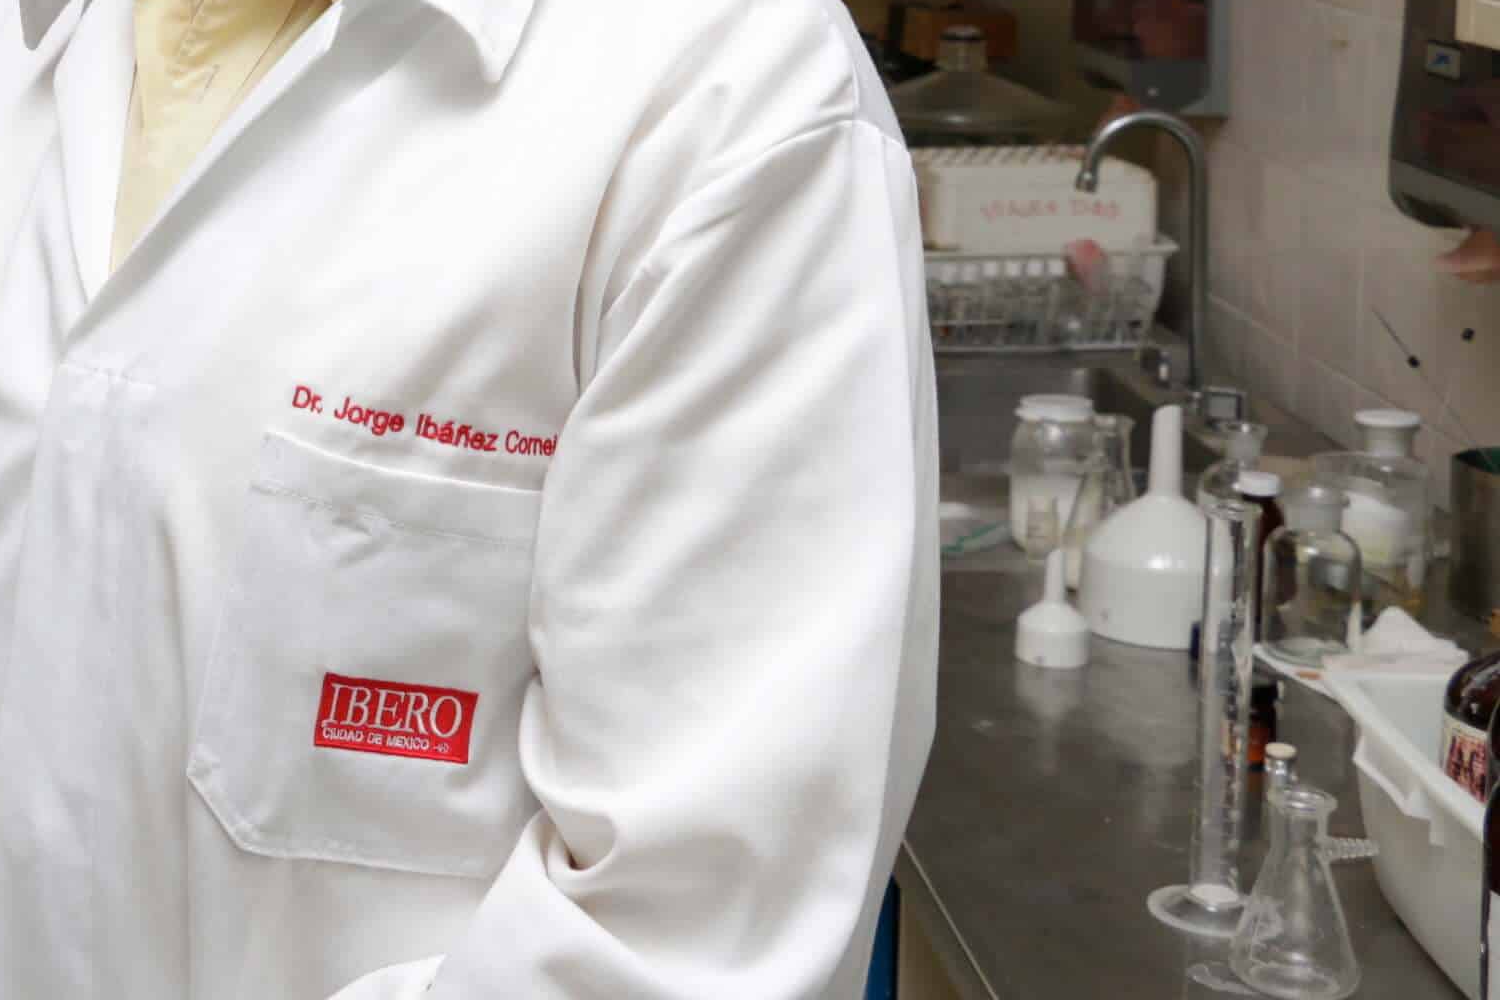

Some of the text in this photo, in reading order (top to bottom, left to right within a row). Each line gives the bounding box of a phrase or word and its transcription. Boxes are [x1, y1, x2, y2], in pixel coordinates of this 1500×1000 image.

[292, 386, 323, 414] Dr.
[334, 397, 406, 436] Jorge
[415, 413, 500, 452] Ibáñez
[321, 682, 463, 739] IBERO
[322, 727, 365, 743] CIUDAD
[367, 732, 383, 745] DE
